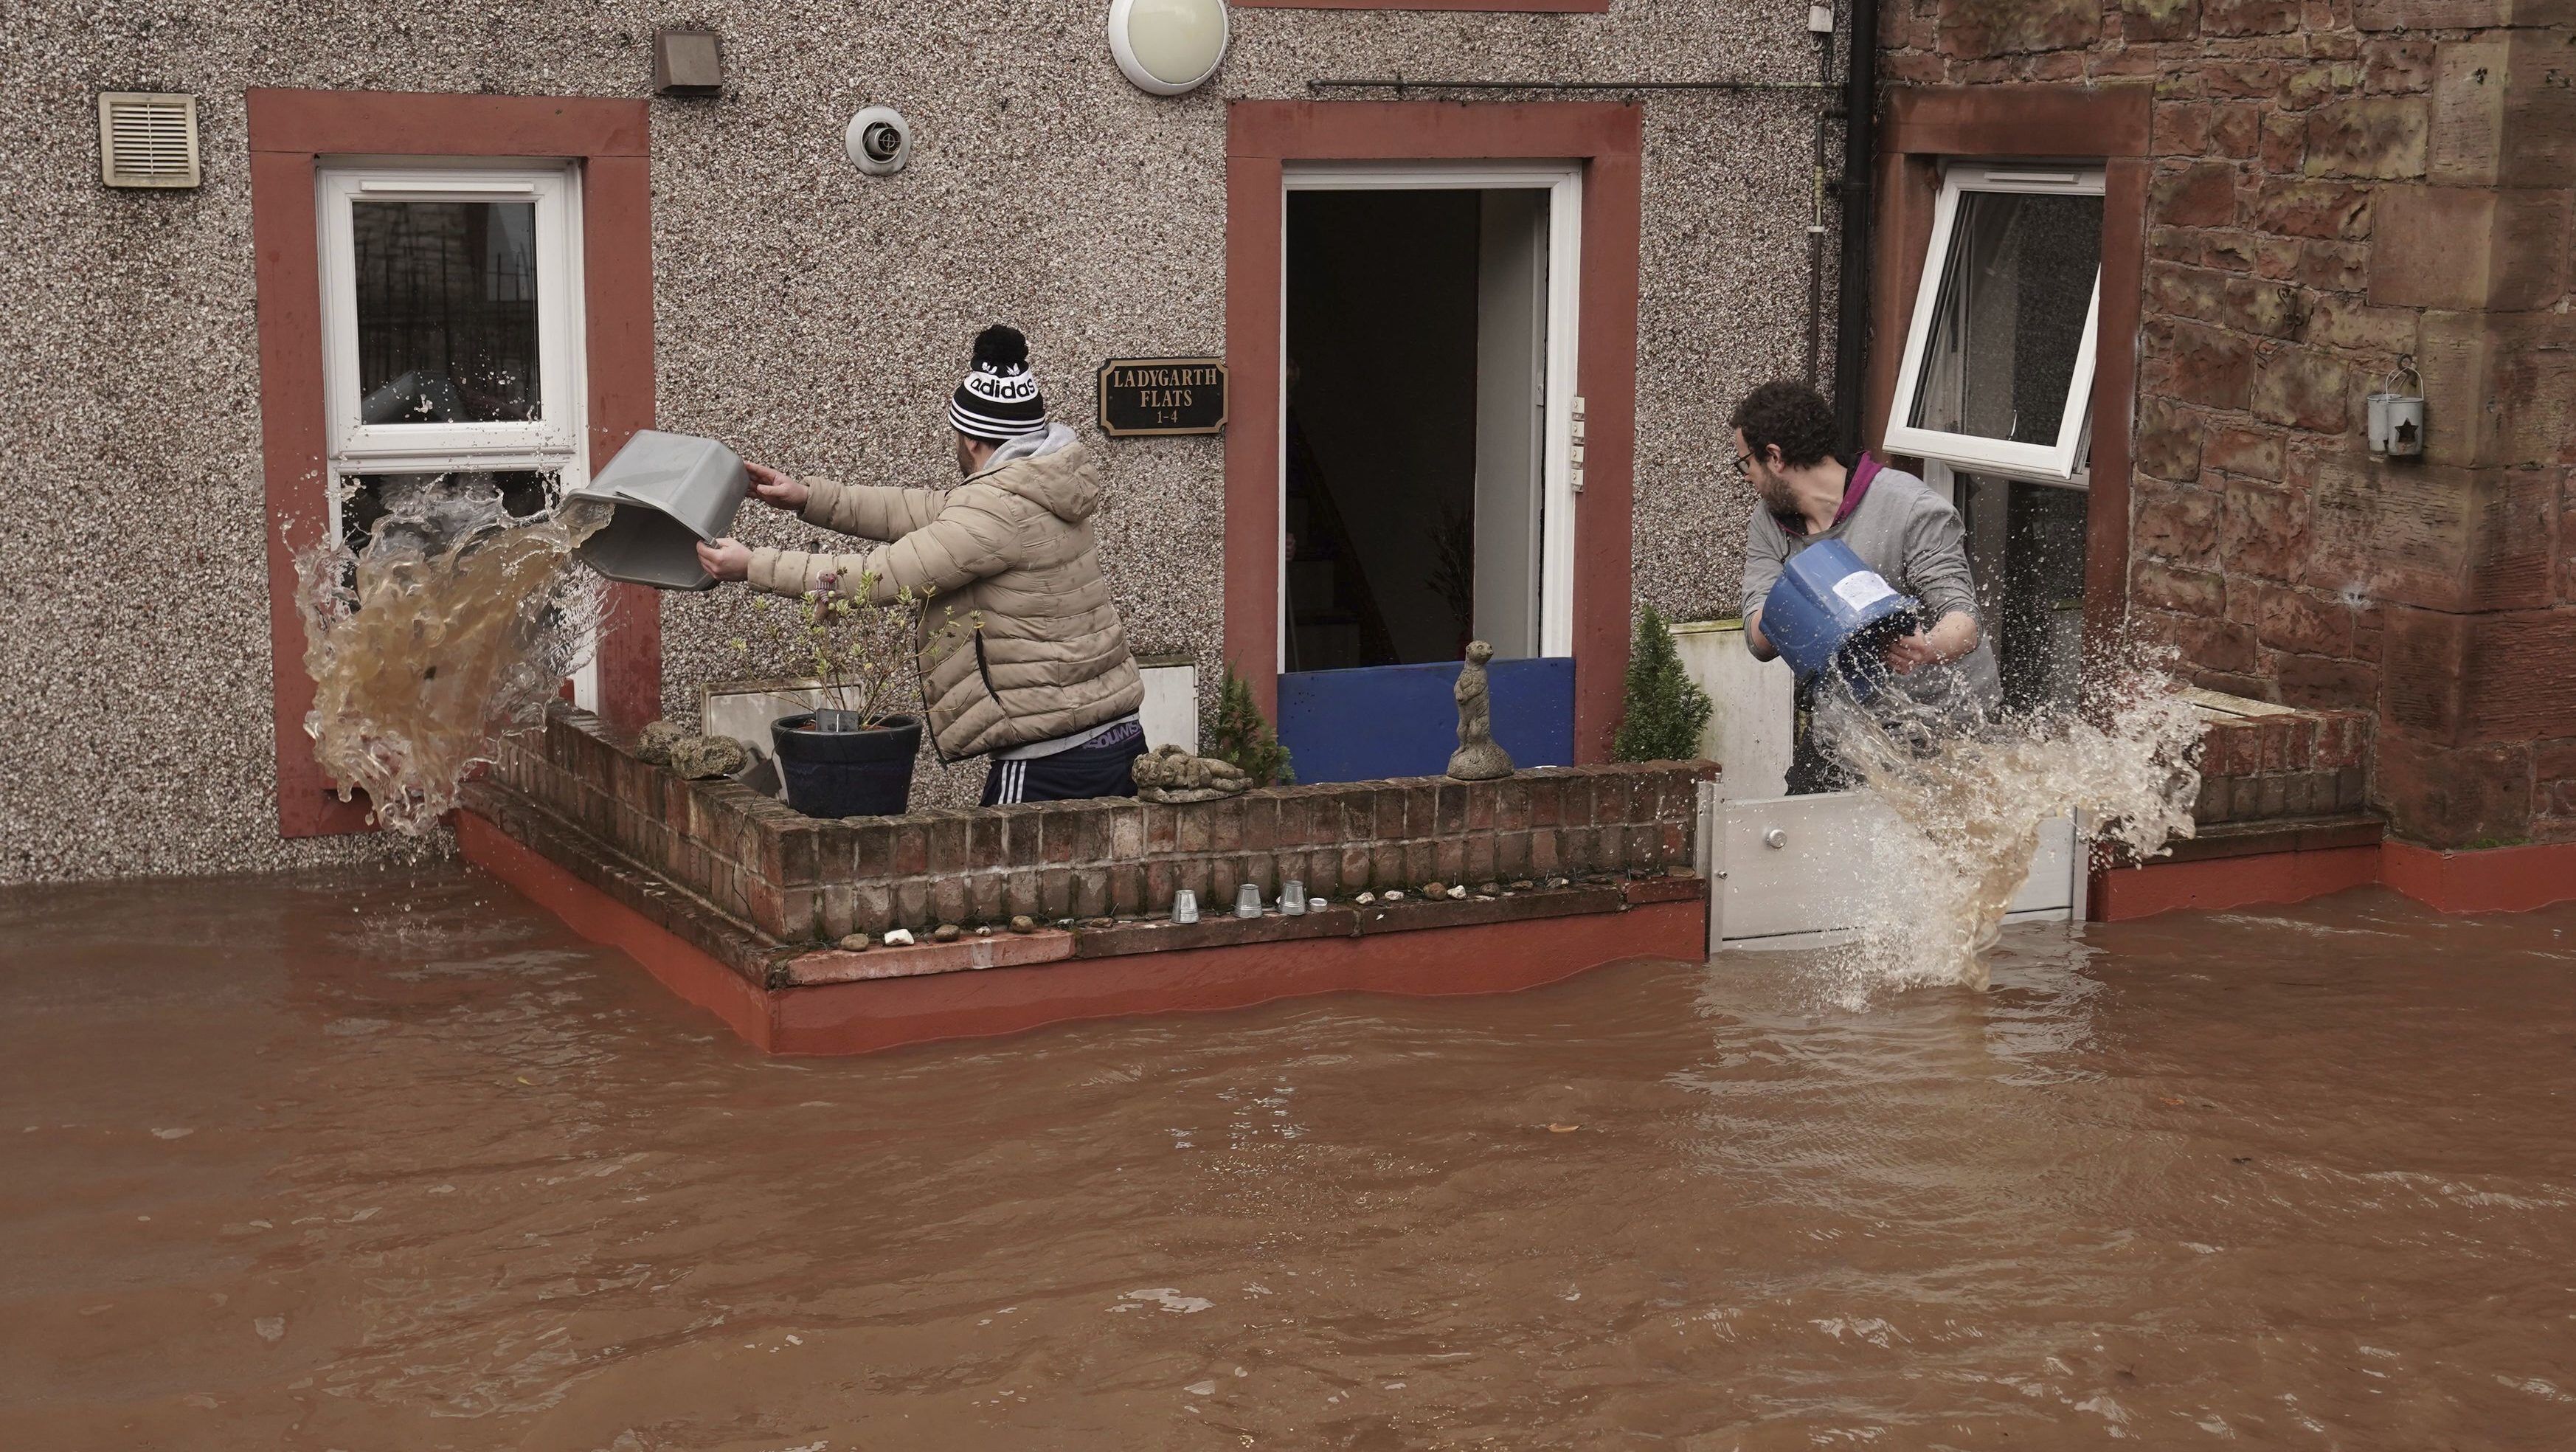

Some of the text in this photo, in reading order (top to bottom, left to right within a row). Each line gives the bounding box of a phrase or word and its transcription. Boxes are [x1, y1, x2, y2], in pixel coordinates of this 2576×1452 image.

[1113, 368, 1217, 387] LADYGARTH
[970, 378, 1036, 399] adidas
[1140, 390, 1193, 407] FLATS
[1157, 410, 1178, 424] 1-4
